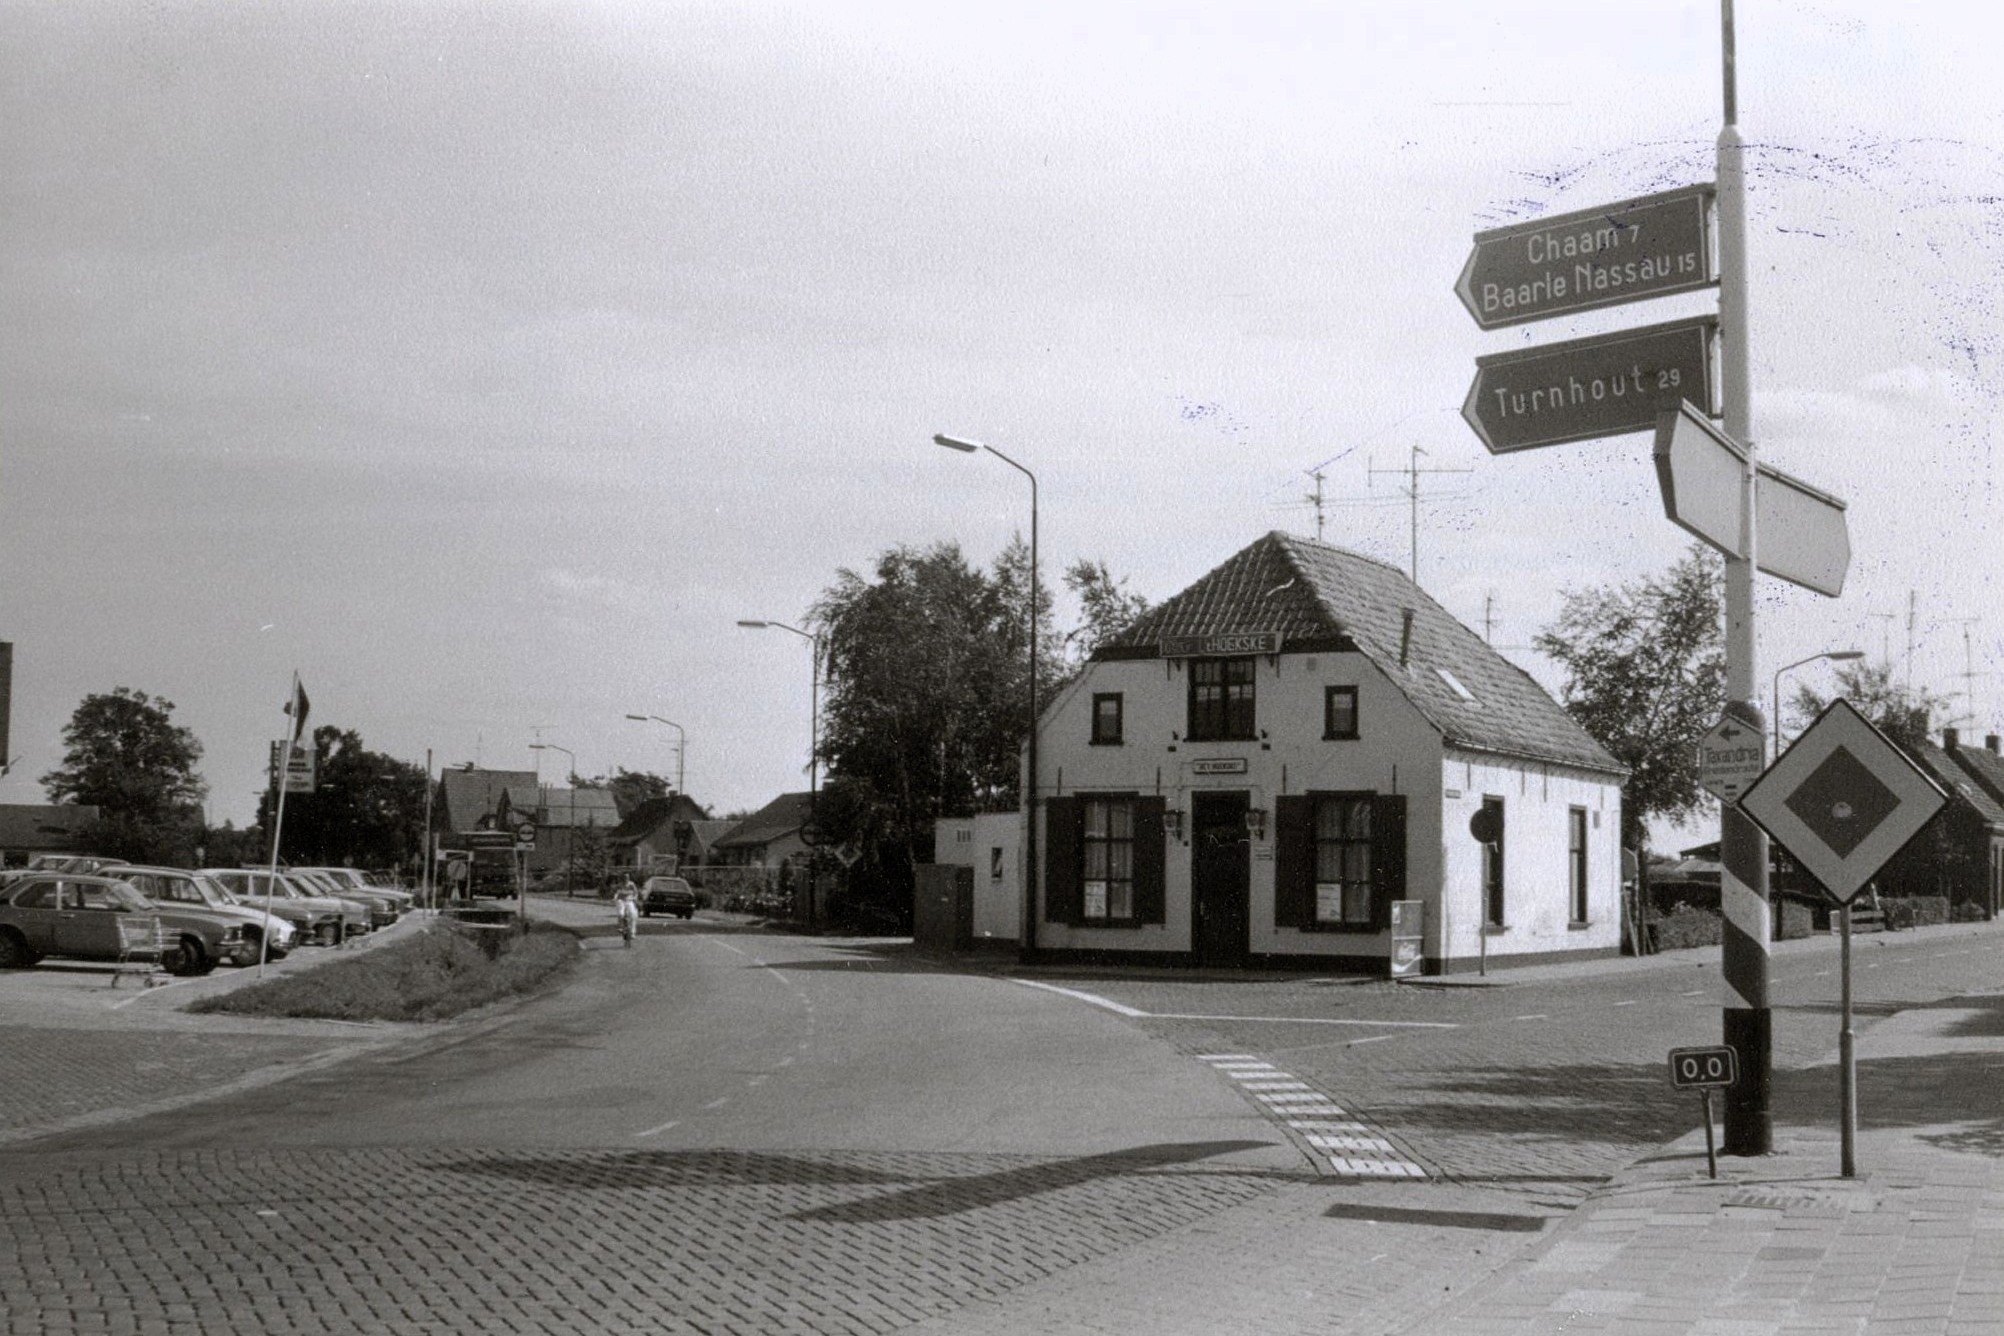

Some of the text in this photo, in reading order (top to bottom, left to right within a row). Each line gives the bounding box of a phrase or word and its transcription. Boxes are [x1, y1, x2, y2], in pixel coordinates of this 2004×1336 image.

[1527, 224, 1640, 265] Chaam 7
[1483, 251, 1696, 313] Baarle Nassau 15
[1494, 364, 1681, 418] Turnhout 29
[1682, 1057, 1722, 1080] 0.0
